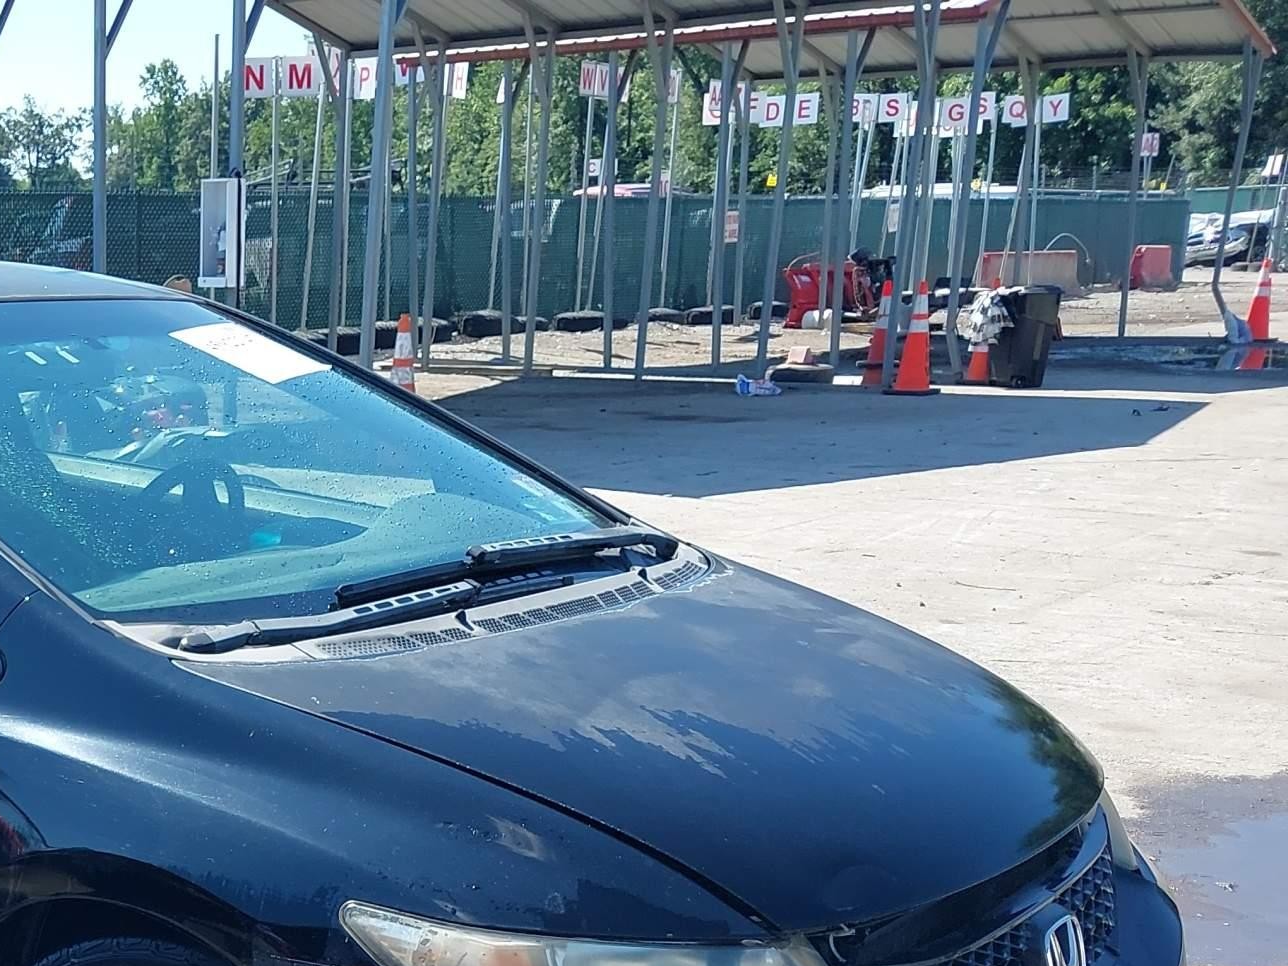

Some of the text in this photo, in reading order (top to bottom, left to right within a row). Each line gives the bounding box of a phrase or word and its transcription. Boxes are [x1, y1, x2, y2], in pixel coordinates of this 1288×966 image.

[245, 65, 264, 90] N
[288, 64, 311, 89] M
[583, 67, 593, 91] W
[766, 102, 780, 121] D
[798, 99, 811, 119] E
[885, 98, 900, 117] S
[948, 103, 964, 122] G
[1009, 100, 1027, 119] Q
[1049, 98, 1063, 117] Y
